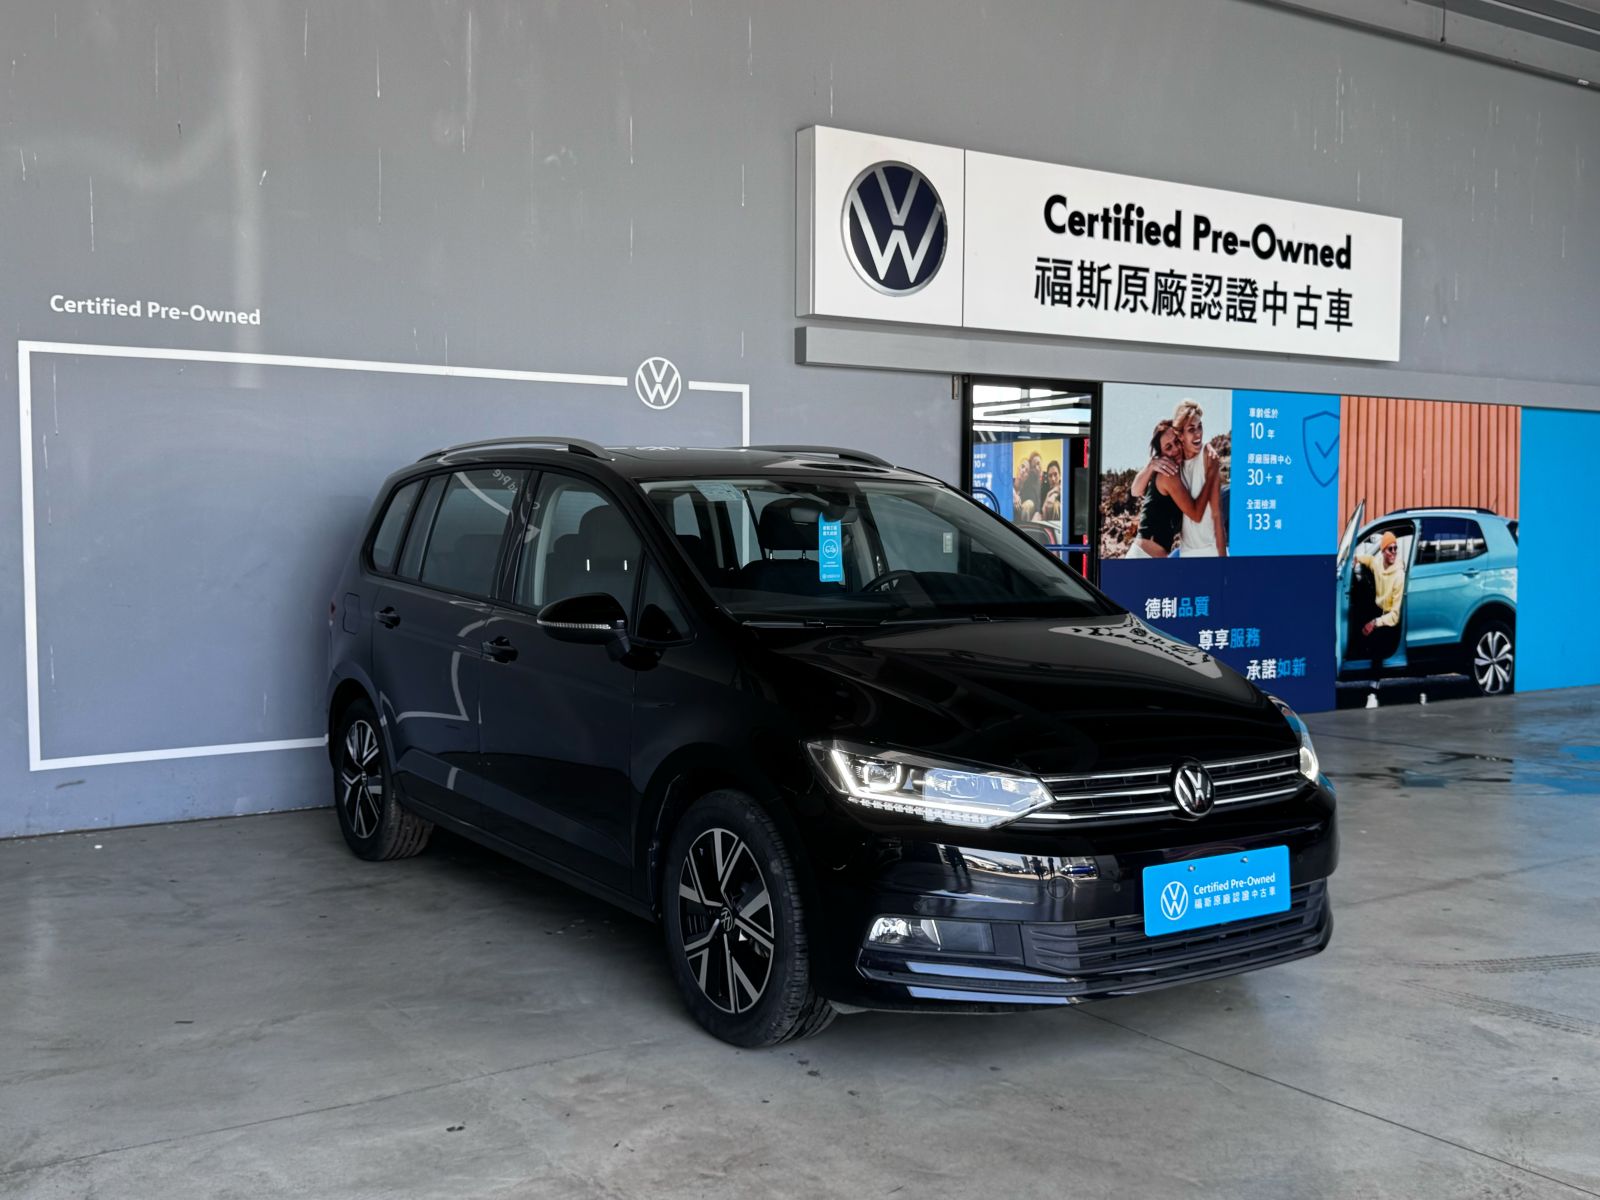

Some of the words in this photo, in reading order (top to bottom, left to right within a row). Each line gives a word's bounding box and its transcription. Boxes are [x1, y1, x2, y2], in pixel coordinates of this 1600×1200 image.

[1043, 193, 1182, 250] Certified
[1192, 213, 1352, 271] Pre-Owned
[1034, 255, 1354, 333] 福斯原廠認證中古車
[49, 294, 142, 318] Certified
[147, 301, 261, 326] Pre-Owned
[1249, 422, 1264, 440] 10
[1247, 513, 1271, 531] 133
[1144, 595, 1211, 620] 德制品質
[1198, 627, 1261, 651] 尊享服務
[1246, 657, 1307, 681] 承諾如新
[1193, 879, 1230, 896] Certified
[1230, 872, 1276, 889] Pre-Owned
[1194, 886, 1276, 909] 福斯原廠認證中古車
